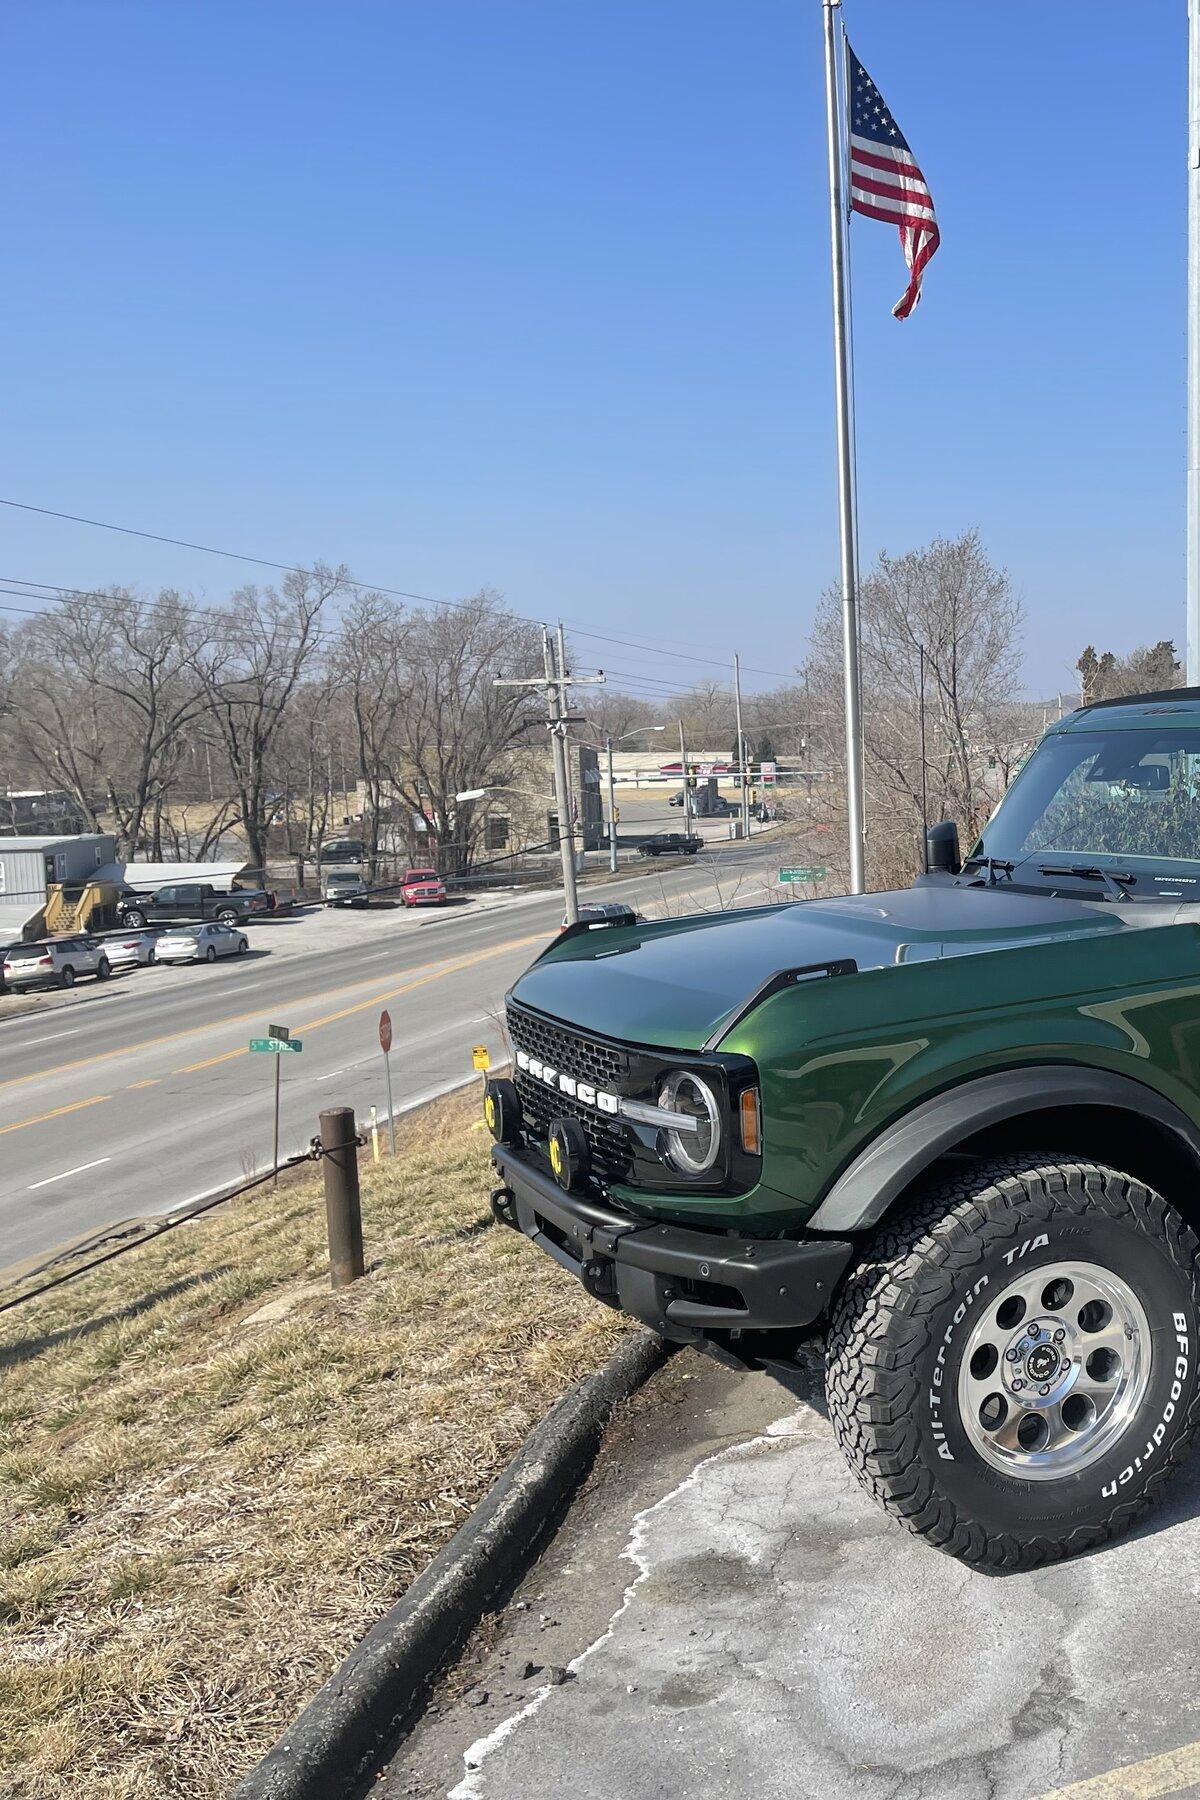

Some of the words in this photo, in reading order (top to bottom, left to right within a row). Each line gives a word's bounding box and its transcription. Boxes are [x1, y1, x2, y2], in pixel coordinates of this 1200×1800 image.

[1154, 876, 1197, 884] BRONCO
[516, 1051, 618, 1114] BRONCO
[929, 1274, 990, 1461] All-Terrain
[1002, 1233, 1050, 1266] T/A
[1029, 1356, 1050, 1378] BRONCO
[1041, 1347, 1056, 1361] FORD
[1101, 1312, 1189, 1499] BFGoodrich
